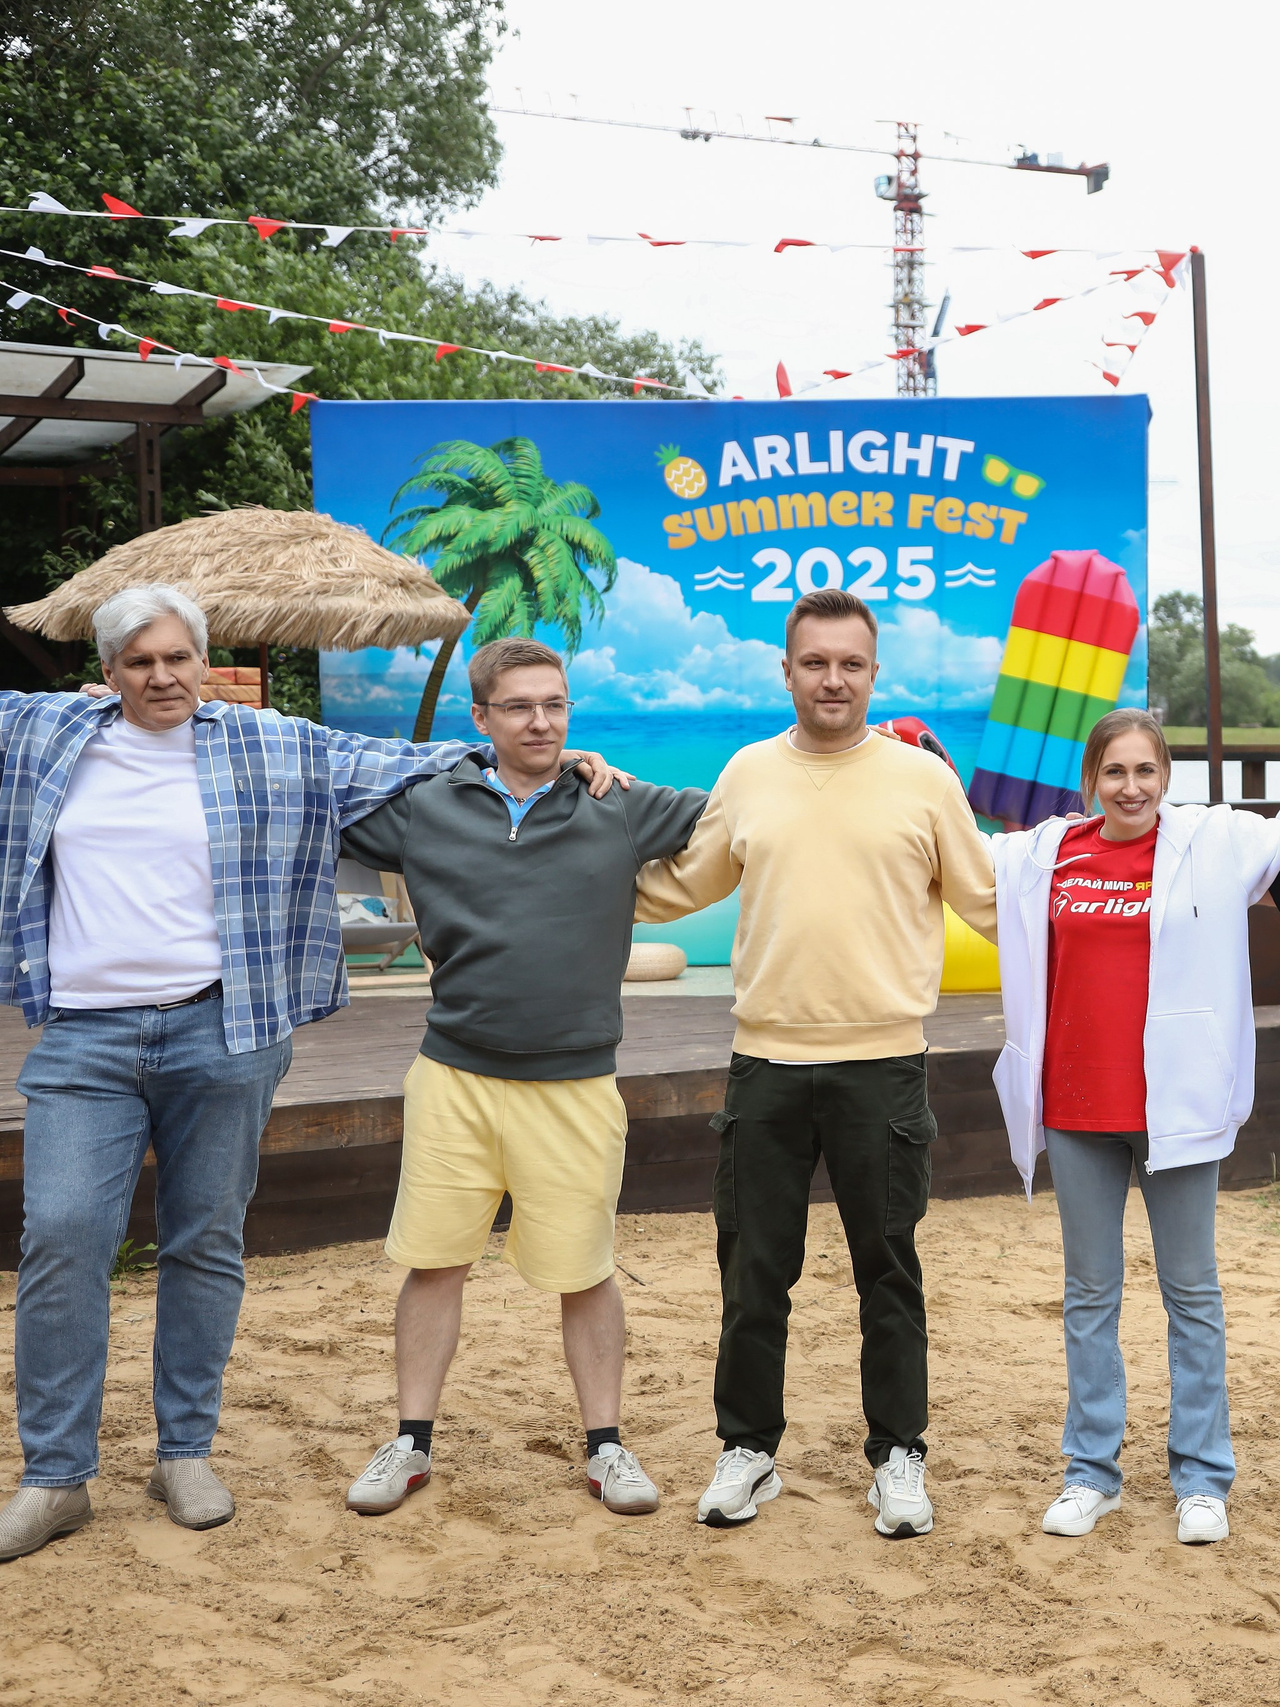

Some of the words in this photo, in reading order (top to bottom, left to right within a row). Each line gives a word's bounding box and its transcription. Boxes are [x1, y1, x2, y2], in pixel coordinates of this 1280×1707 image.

[718, 430, 975, 487] ARLIGHT
[751, 546, 936, 602] 2025
[1056, 878, 1104, 890] ДЕЛАЙ
[1103, 880, 1134, 891] МИР
[1135, 881, 1153, 891] ЯР
[1070, 897, 1152, 917] arligh
